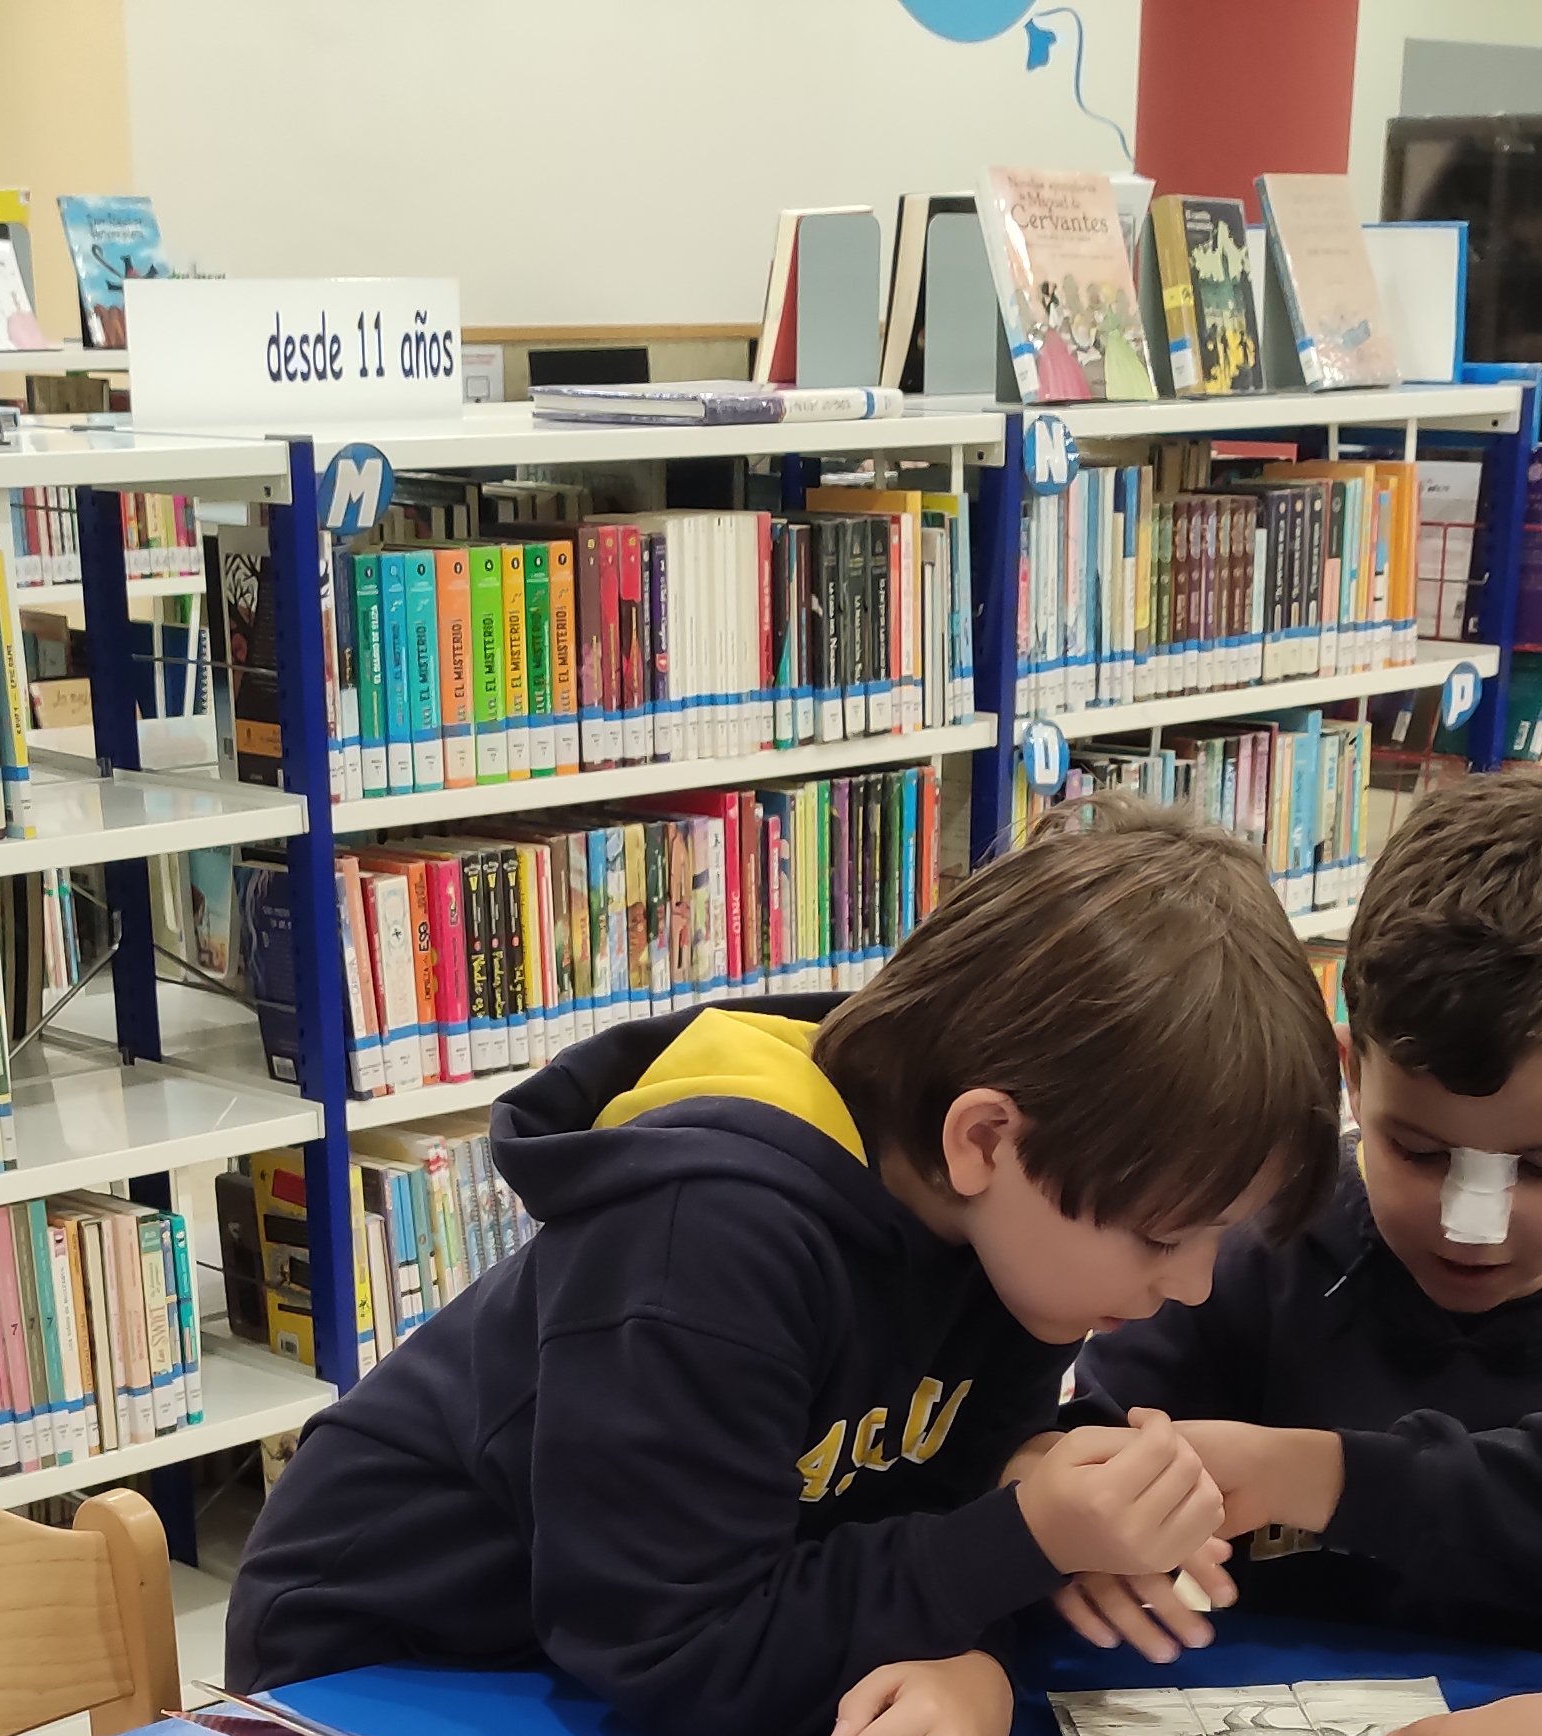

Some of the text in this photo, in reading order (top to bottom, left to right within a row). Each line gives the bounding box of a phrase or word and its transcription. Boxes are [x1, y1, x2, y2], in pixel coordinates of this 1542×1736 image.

[1009, 208, 1109, 235] Cervantes
[266, 310, 455, 383] desde 11 años
[1036, 418, 1070, 485] N
[325, 458, 383, 528] M
[511, 674, 522, 688] EL
[558, 669, 569, 683] EL
[454, 683, 464, 698] EL
[485, 677, 496, 692] EL
[420, 687, 430, 702] EL
